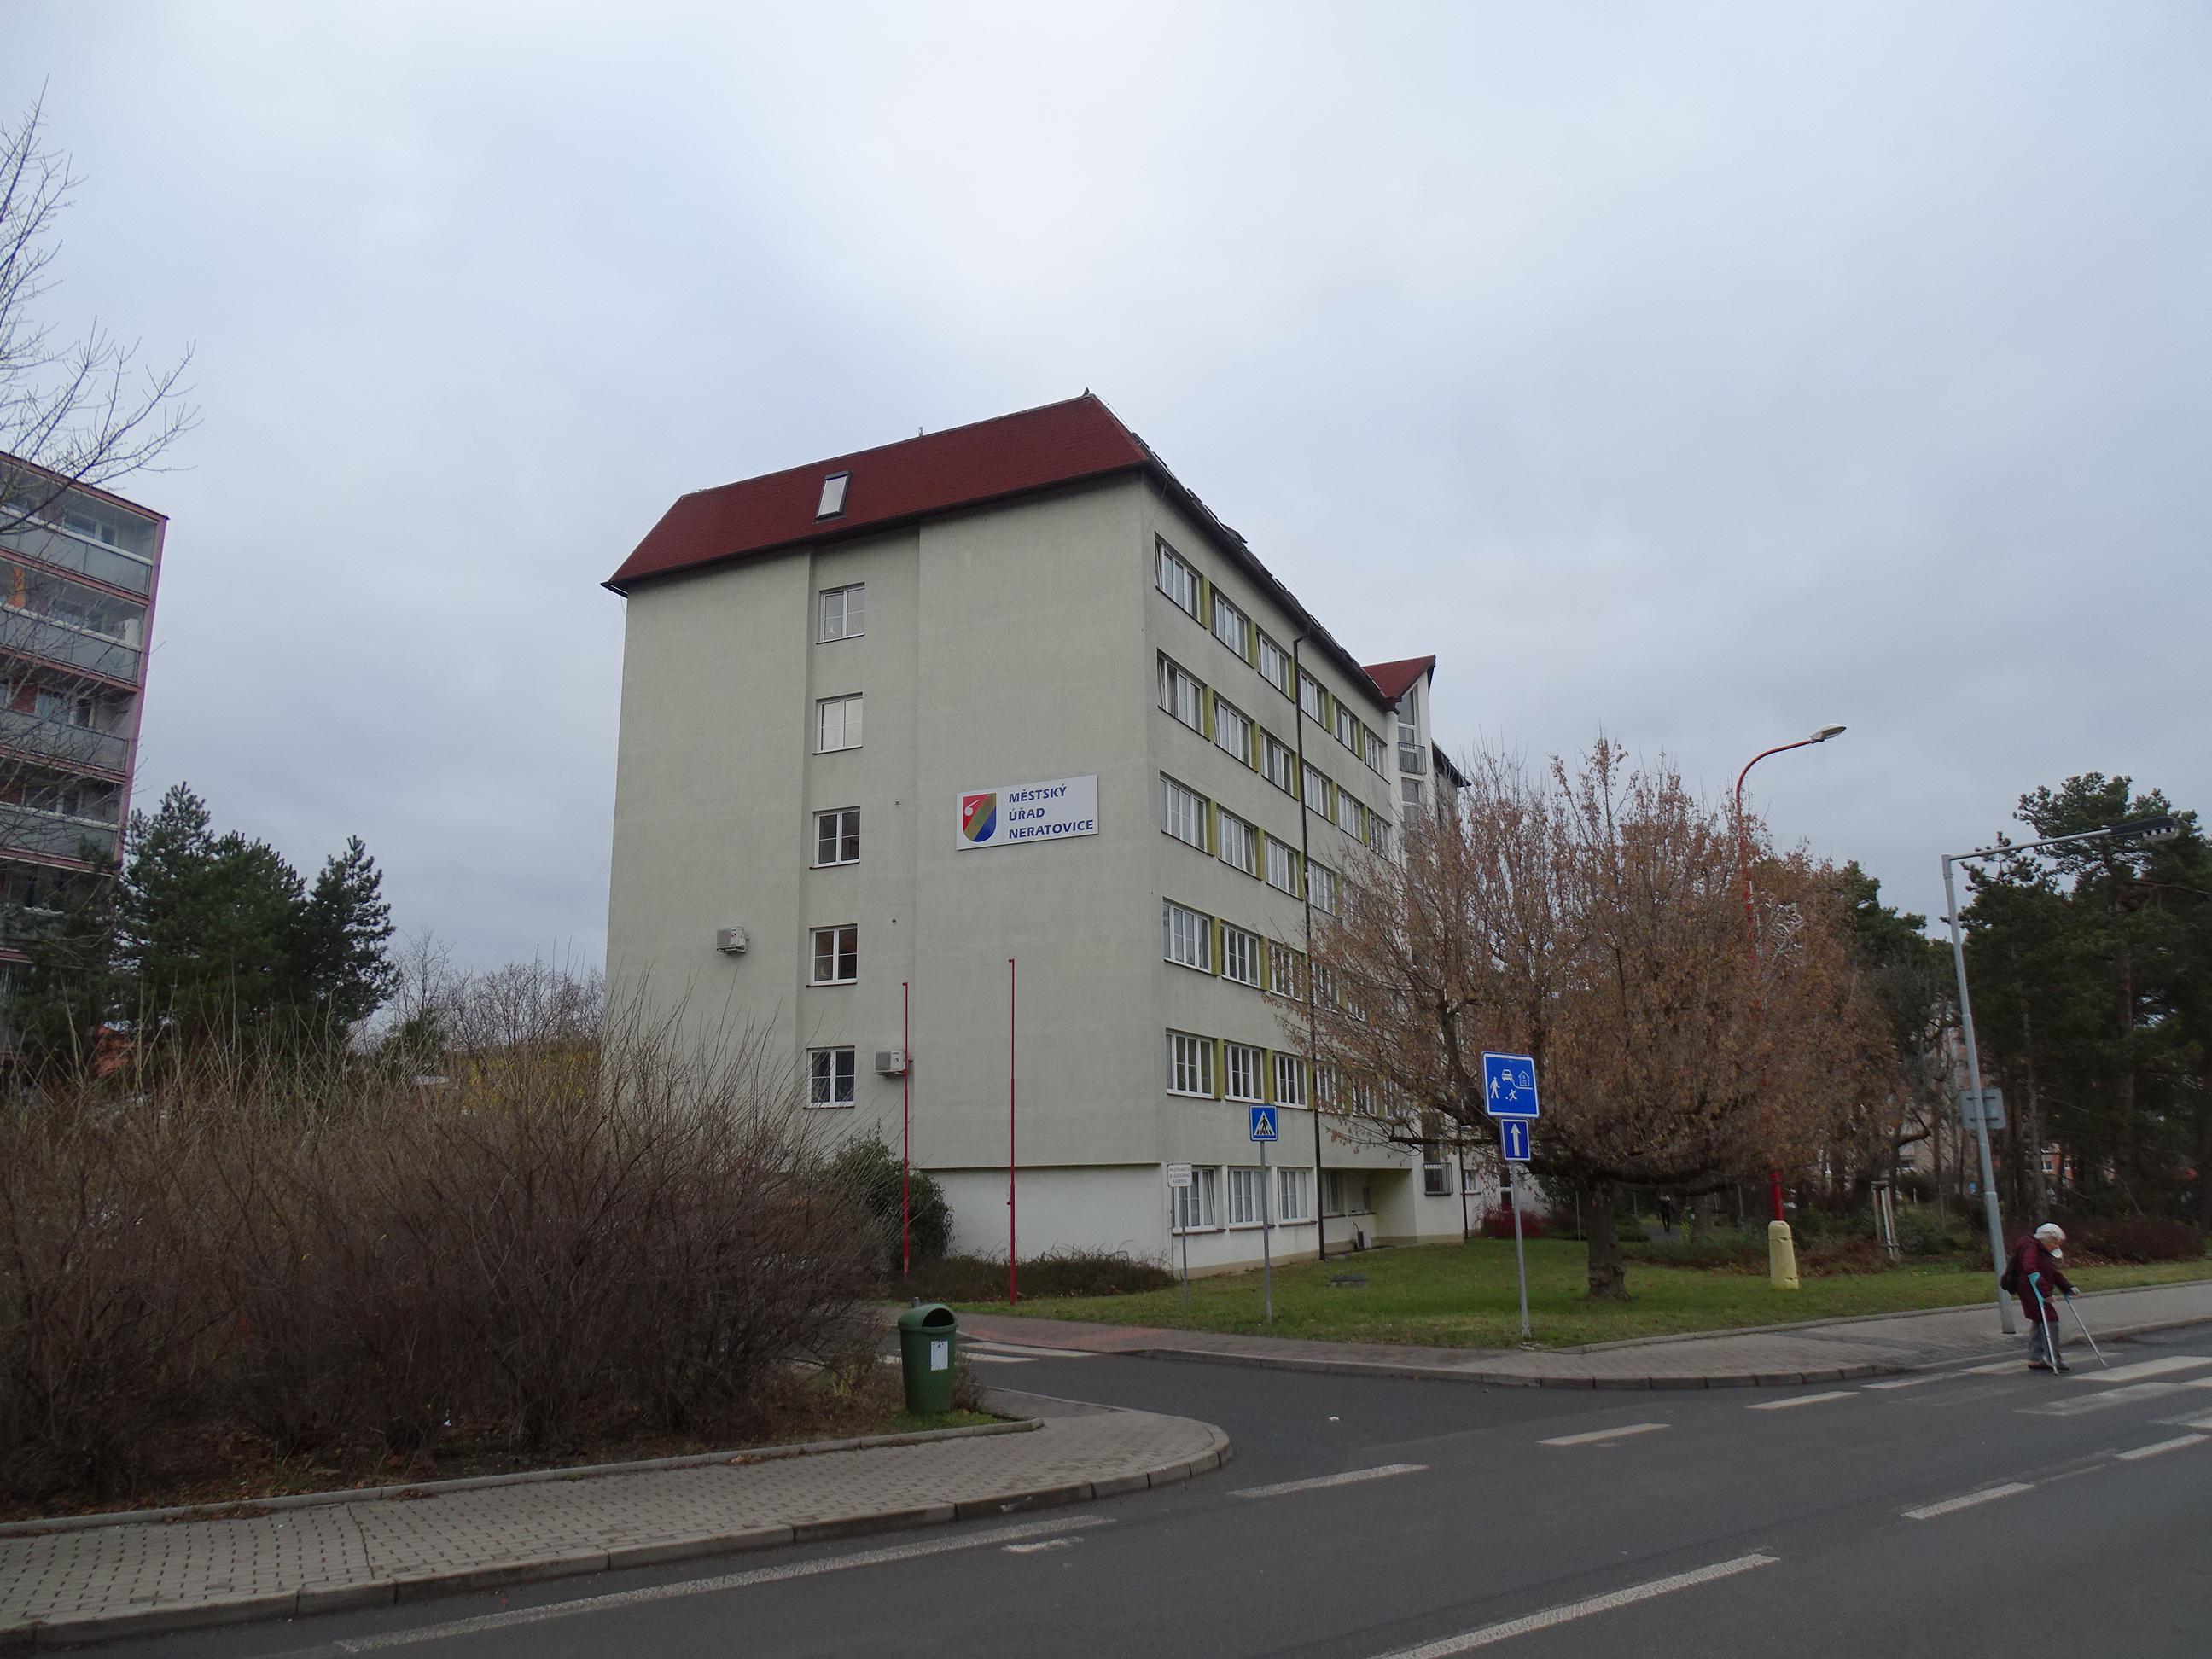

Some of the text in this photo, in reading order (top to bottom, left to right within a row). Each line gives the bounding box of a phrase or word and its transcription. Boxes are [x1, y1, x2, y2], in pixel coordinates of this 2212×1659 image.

[1009, 783, 1067, 803] MĚSTSKÝ
[1009, 808, 1045, 821] ÚŘAD
[1009, 819, 1094, 839] NERATOVICE
